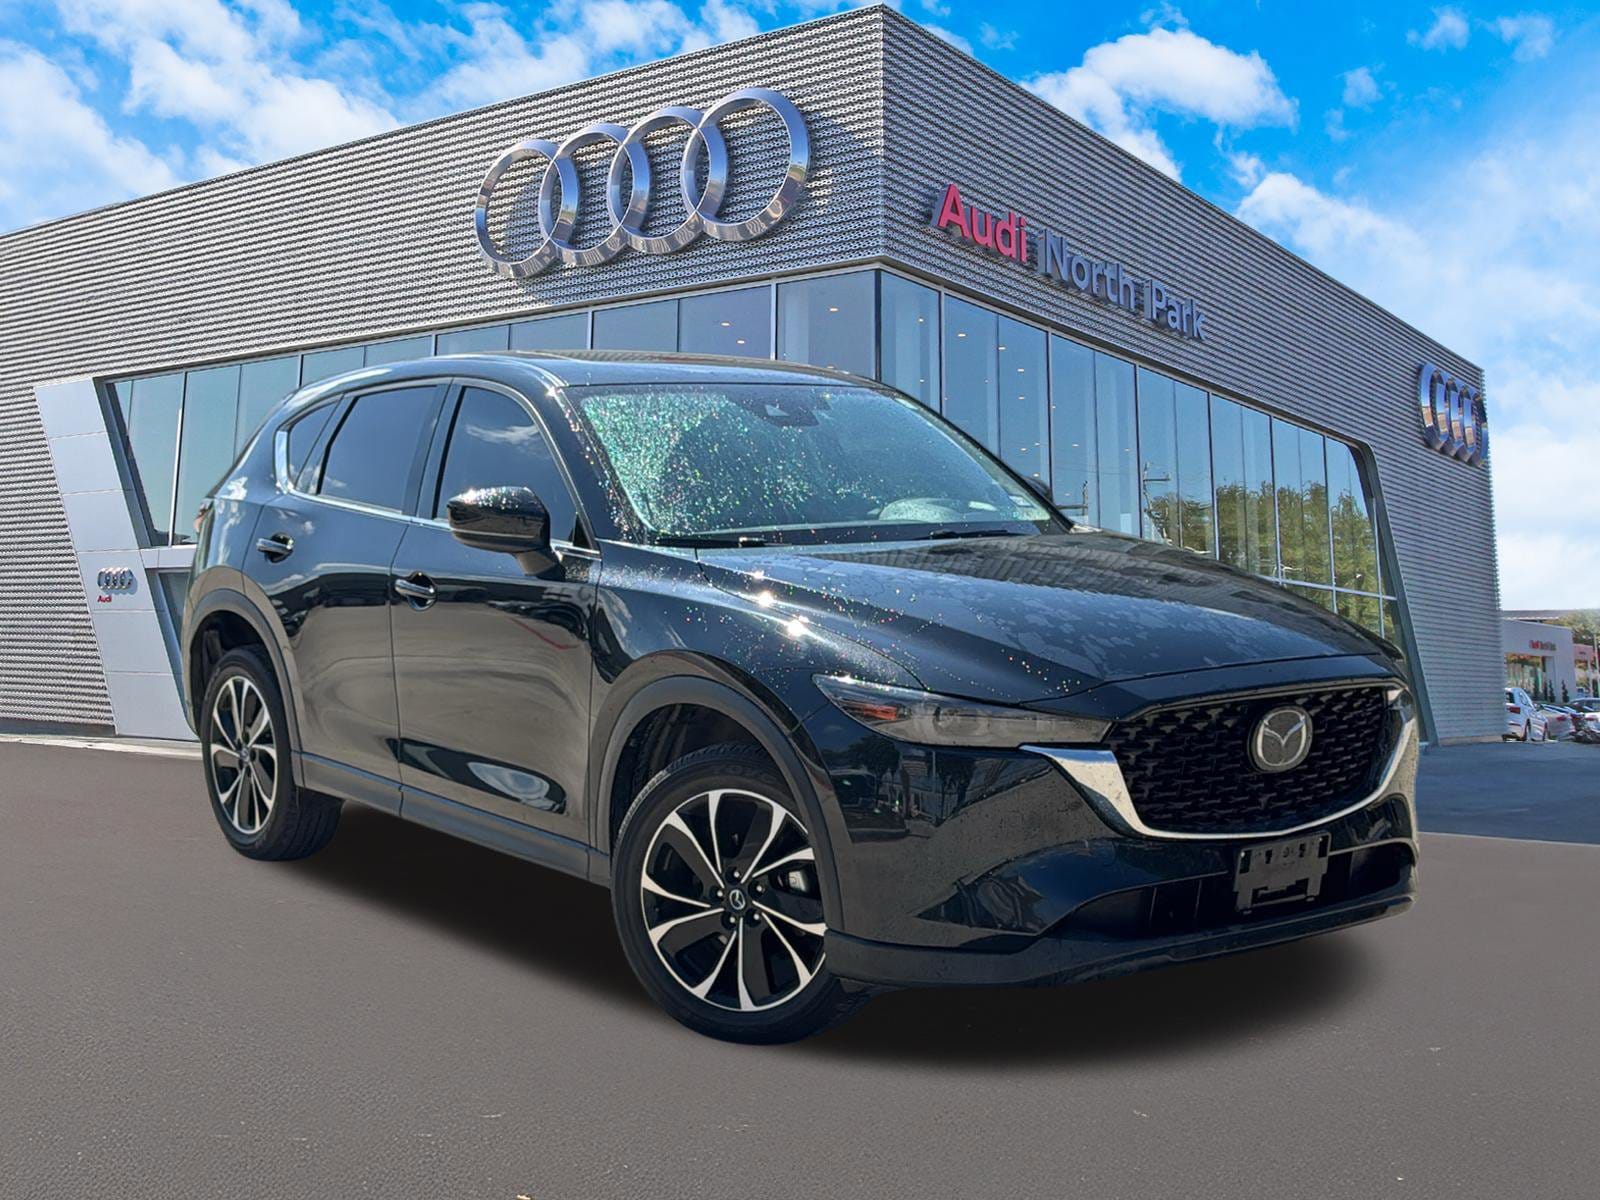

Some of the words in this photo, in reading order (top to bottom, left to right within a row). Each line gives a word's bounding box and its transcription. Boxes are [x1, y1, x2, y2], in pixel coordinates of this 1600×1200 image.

[936, 183, 1028, 264] Audi
[1043, 229, 1136, 310] North
[1150, 279, 1206, 340] Park
